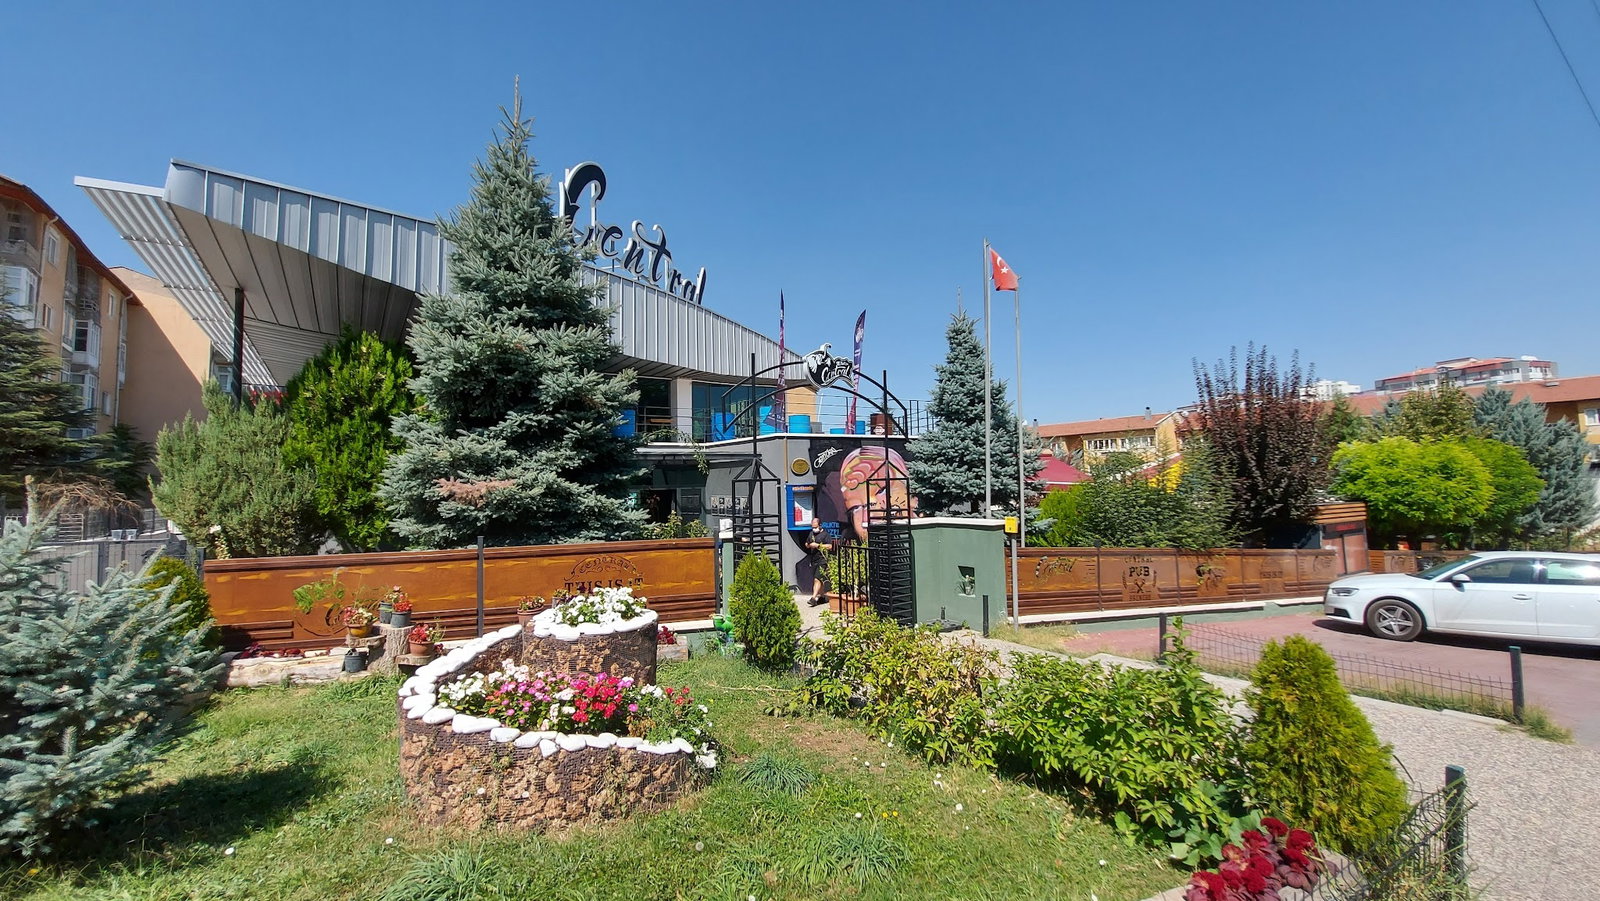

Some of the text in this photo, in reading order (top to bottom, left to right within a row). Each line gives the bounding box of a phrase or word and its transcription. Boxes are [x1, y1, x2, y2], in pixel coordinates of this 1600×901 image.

[1129, 566, 1150, 577] PUB
[564, 580, 603, 594] THIS
[608, 579, 624, 589] IS
